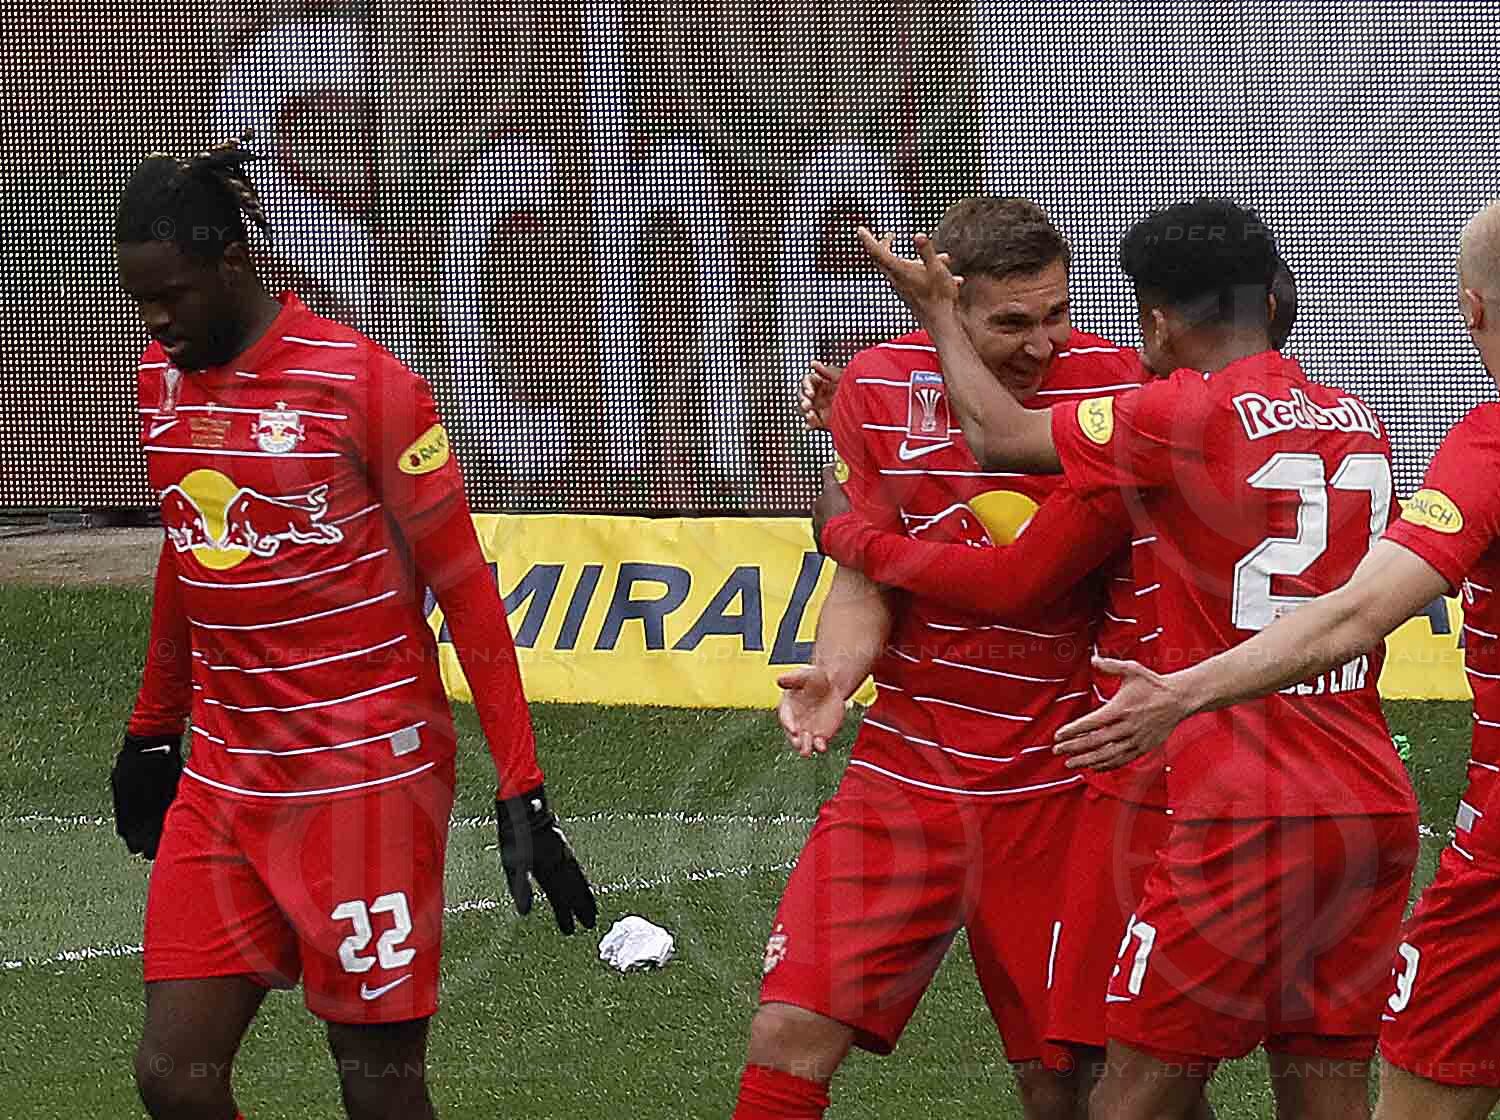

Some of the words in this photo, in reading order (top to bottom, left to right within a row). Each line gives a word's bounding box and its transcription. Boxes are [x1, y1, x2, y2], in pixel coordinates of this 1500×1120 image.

[1232, 453, 1393, 632] 27
[427, 552, 826, 665] MIRAL
[331, 891, 416, 973] 22
